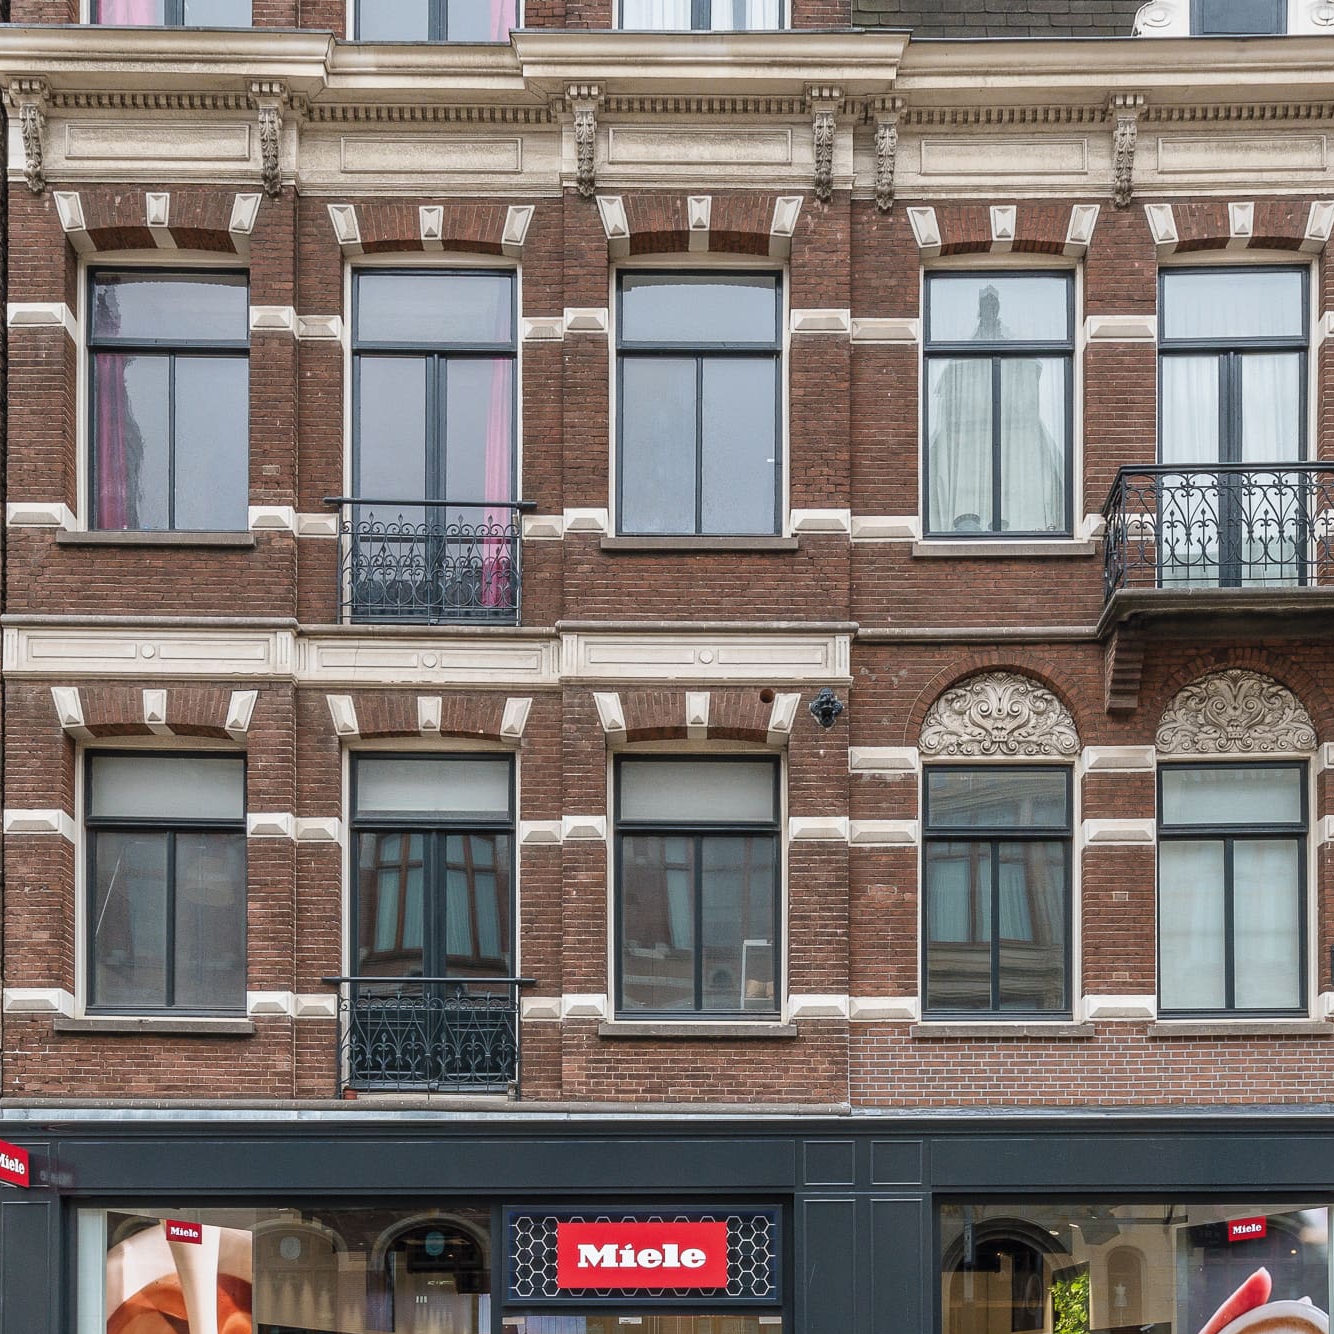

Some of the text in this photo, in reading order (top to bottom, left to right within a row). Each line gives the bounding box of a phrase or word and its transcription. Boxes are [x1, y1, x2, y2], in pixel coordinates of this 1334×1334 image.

[170, 1226, 199, 1239] Miele
[1232, 1223, 1262, 1235] Miele
[577, 1242, 707, 1269] Miele
